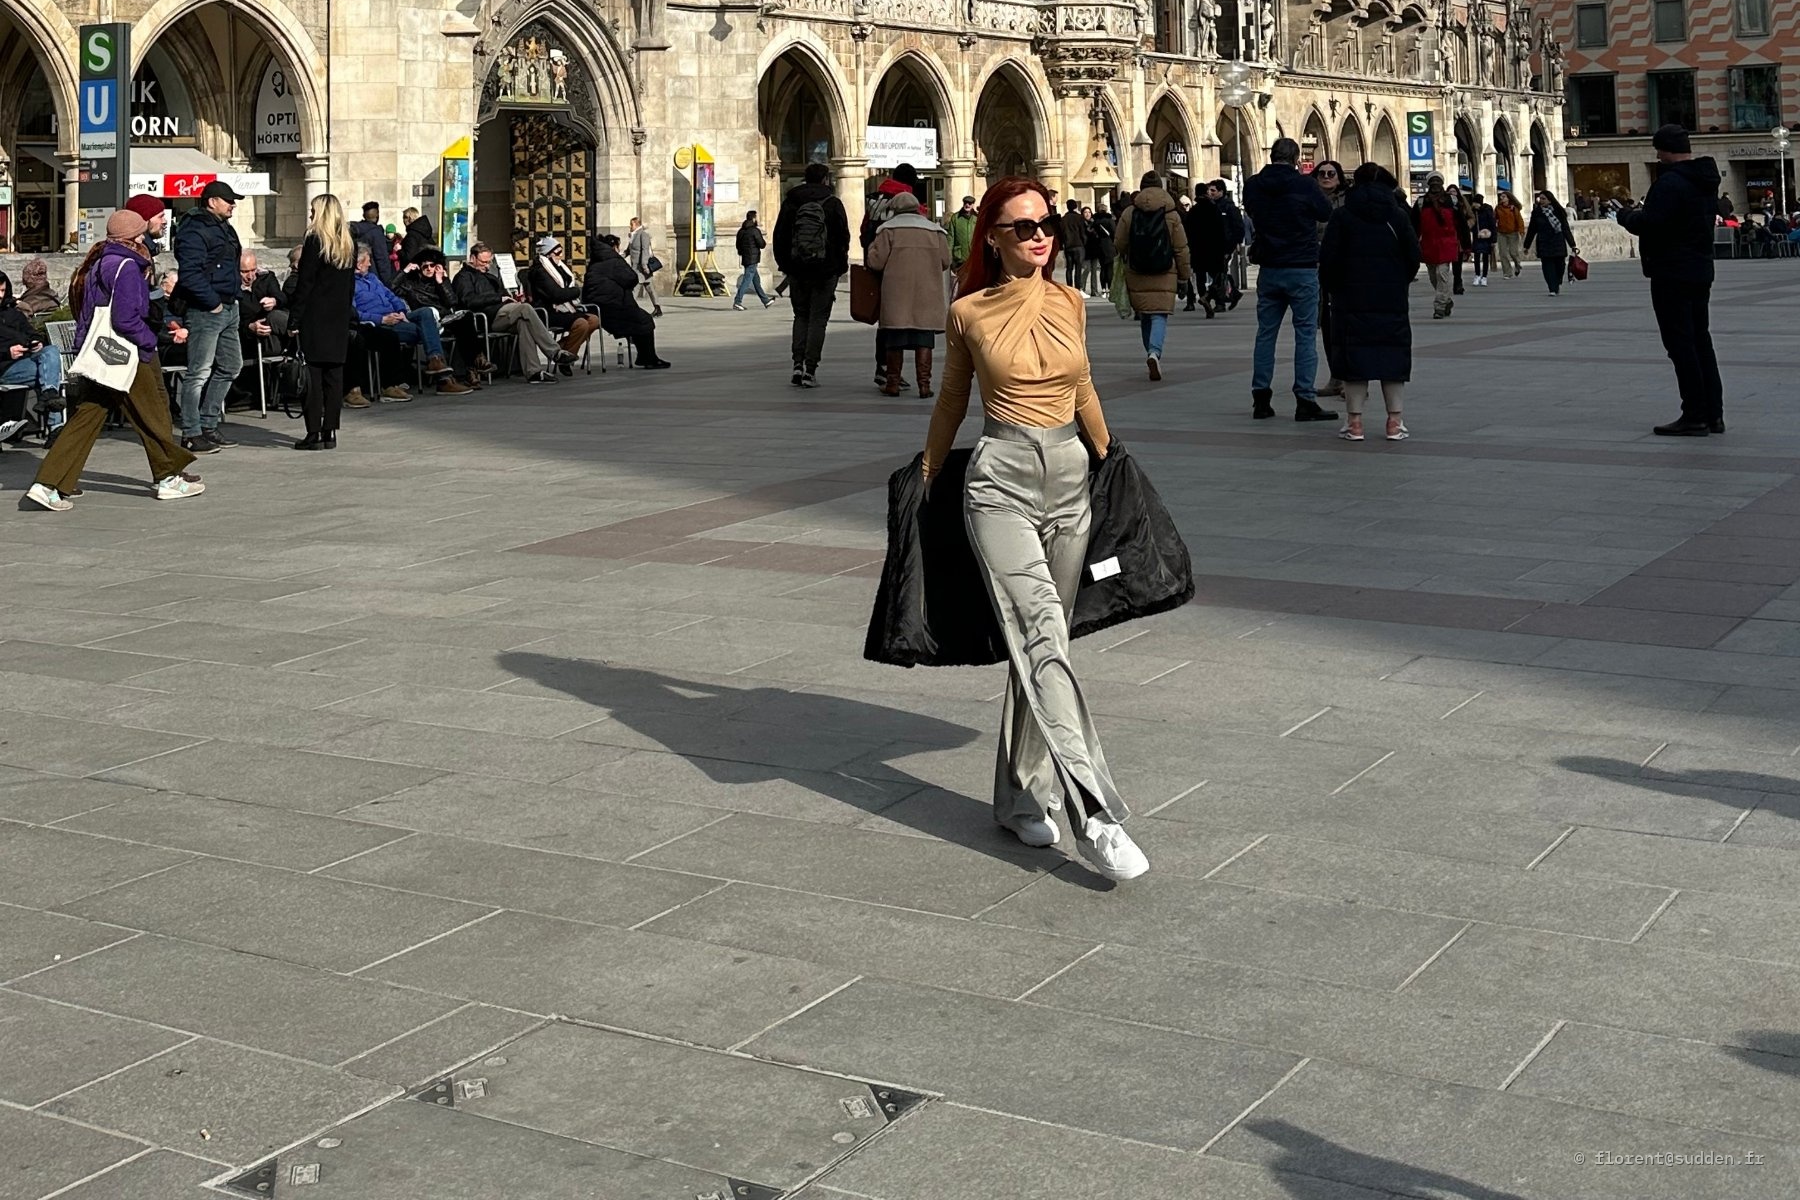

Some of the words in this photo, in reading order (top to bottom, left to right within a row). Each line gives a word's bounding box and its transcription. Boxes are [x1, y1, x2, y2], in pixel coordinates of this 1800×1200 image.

[88, 32, 111, 72] S
[87, 85, 109, 125] U
[131, 115, 179, 137] ORN
[267, 113, 296, 126] OPTI
[1412, 114, 1427, 133] S
[81, 143, 116, 152] Marienplatz
[1413, 138, 1427, 157] U
